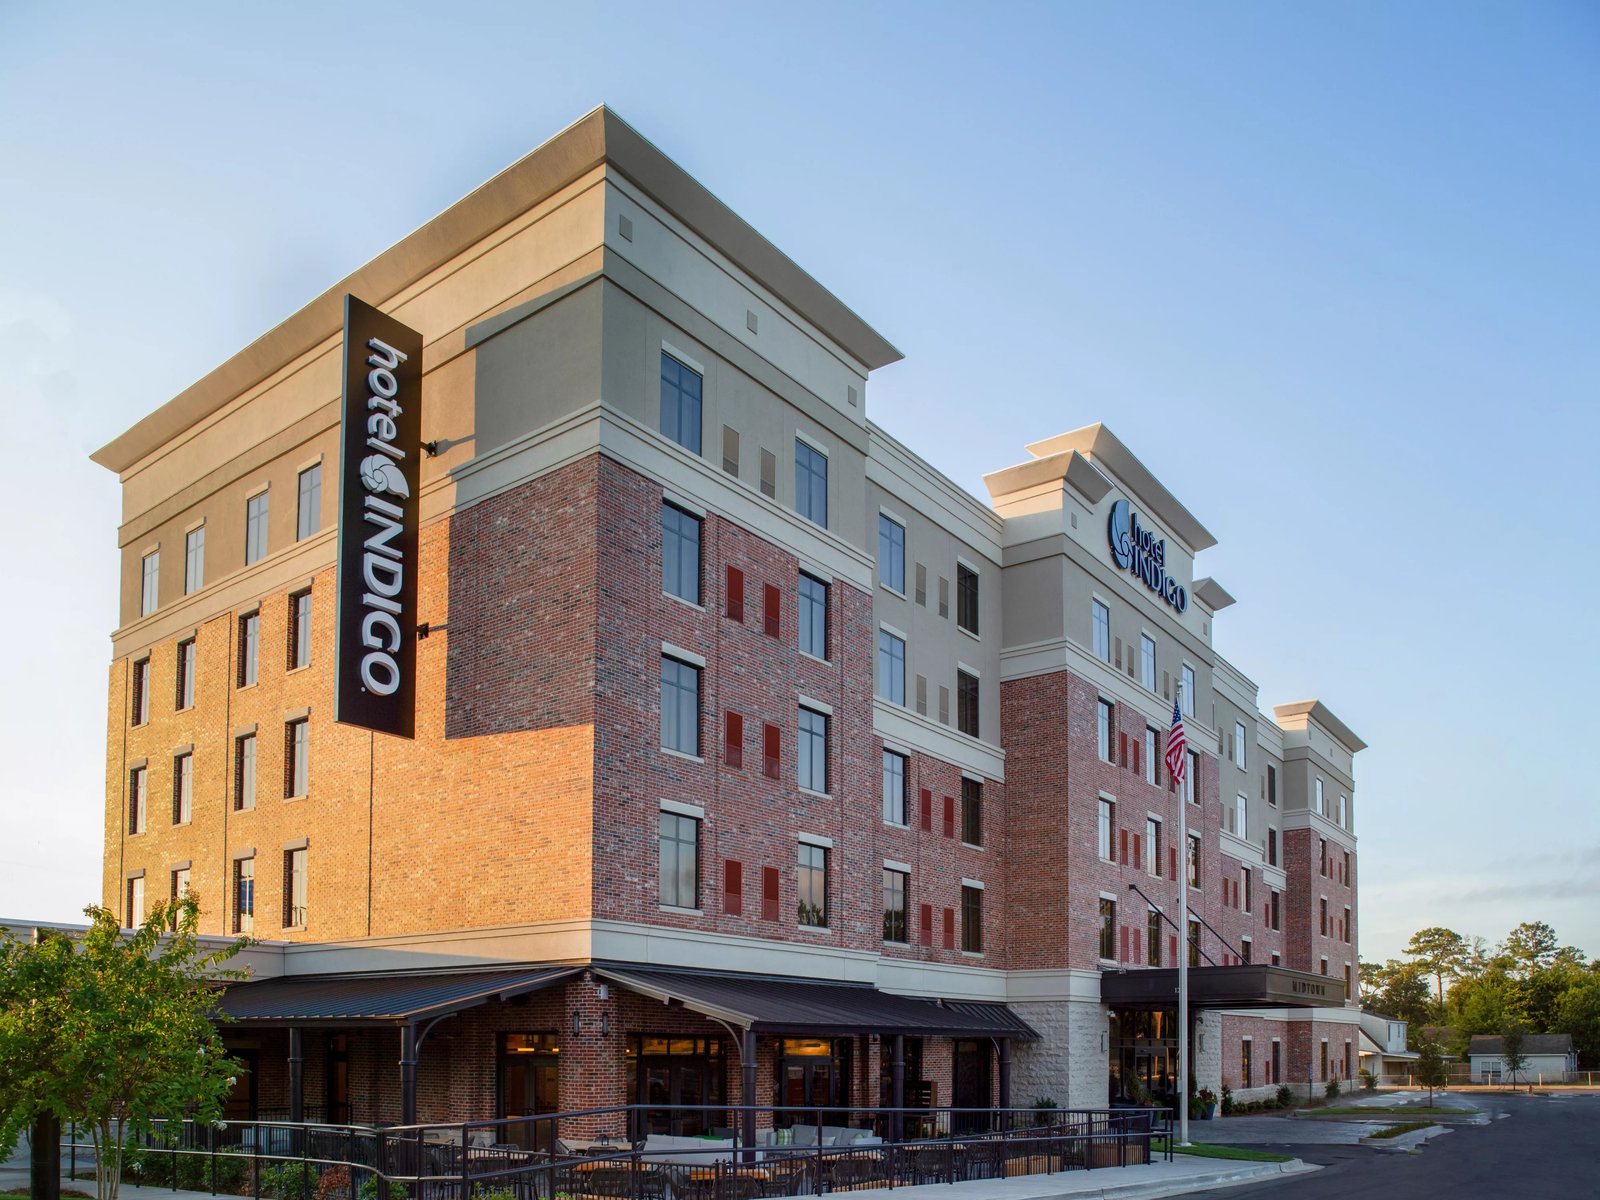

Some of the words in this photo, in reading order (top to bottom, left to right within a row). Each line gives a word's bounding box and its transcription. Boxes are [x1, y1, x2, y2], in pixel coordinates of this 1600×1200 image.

[368, 337, 408, 460] hotel
[1131, 512, 1165, 567] hotel
[361, 494, 404, 697] INDIGO
[1131, 544, 1188, 613] INDIGO
[1292, 980, 1326, 996] MIDTOWN
